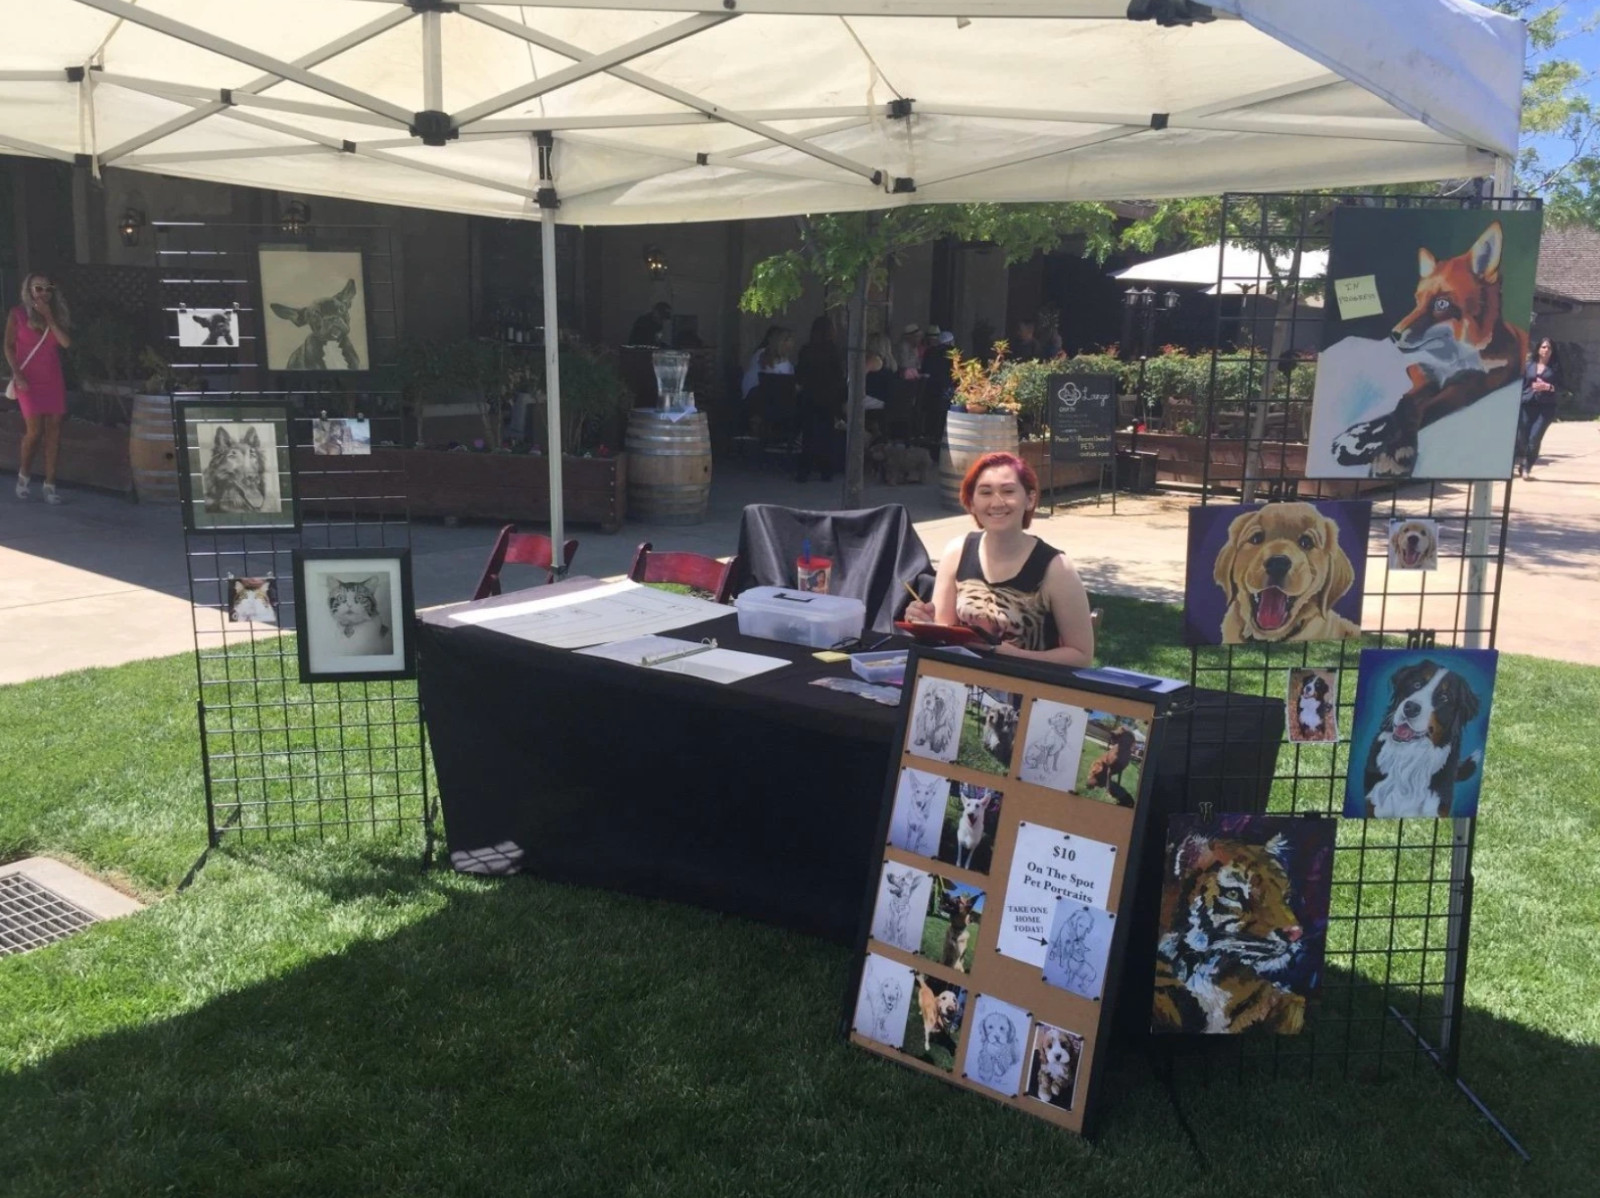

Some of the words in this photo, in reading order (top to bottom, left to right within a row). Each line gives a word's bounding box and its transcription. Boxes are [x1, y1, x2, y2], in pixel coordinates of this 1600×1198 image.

[1345, 281, 1360, 291] IN
[1052, 845, 1076, 862] $10
[1027, 861, 1043, 874] On
[1046, 866, 1068, 881] The
[1069, 875, 1095, 890] Spot
[1023, 875, 1041, 888] Pet
[1043, 881, 1093, 904] Portraits
[1008, 906, 1029, 914] TAKE
[1015, 915, 1041, 923] HOME
[1013, 925, 1044, 933] TODAY!
